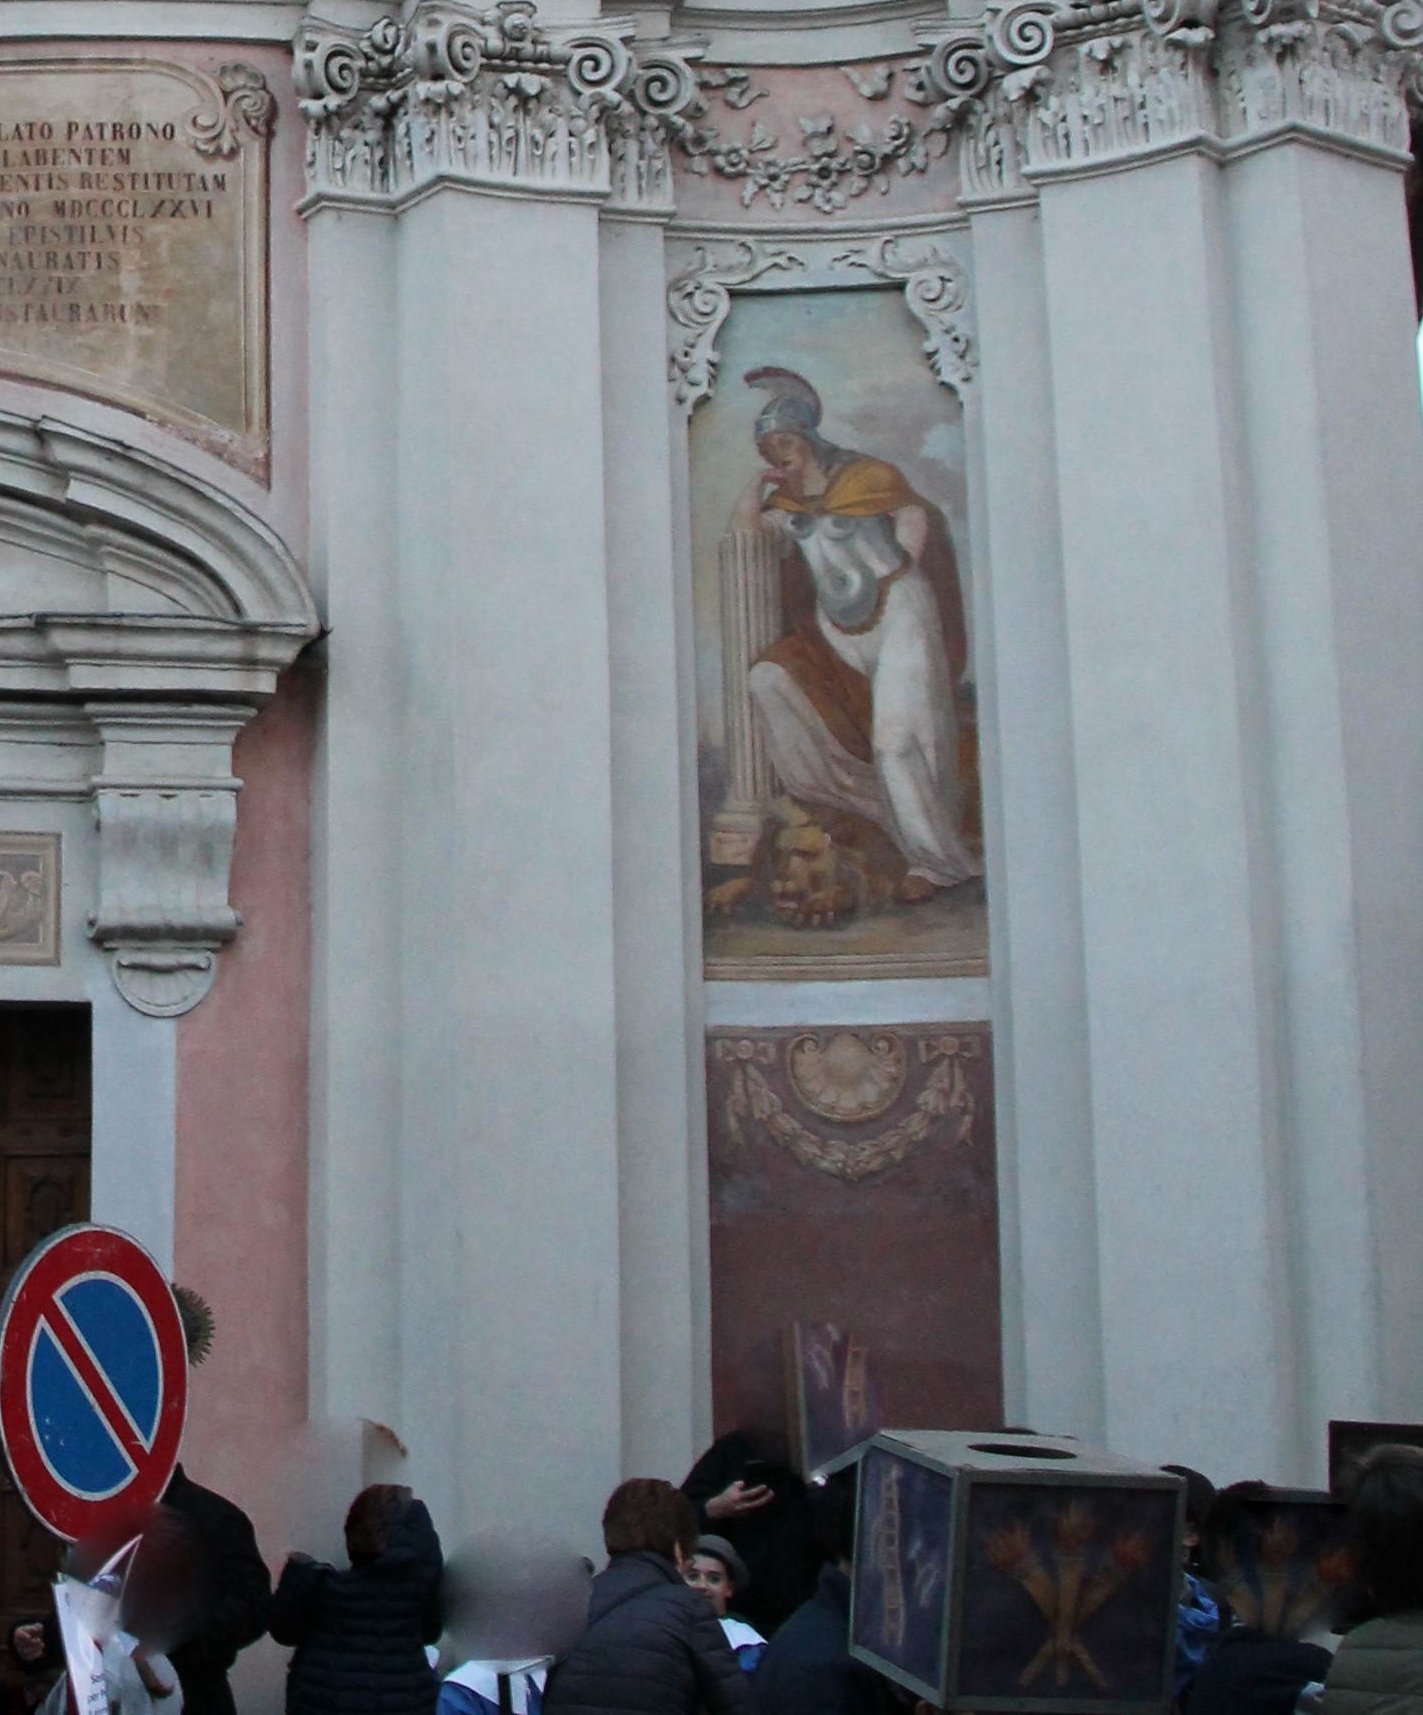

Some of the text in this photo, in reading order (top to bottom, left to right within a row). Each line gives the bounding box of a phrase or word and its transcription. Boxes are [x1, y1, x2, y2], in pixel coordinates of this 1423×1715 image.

[67, 121, 175, 141] PATRONO
[80, 171, 227, 193] RESTITUTAM
[53, 198, 213, 220] MDCCCLXXVI
